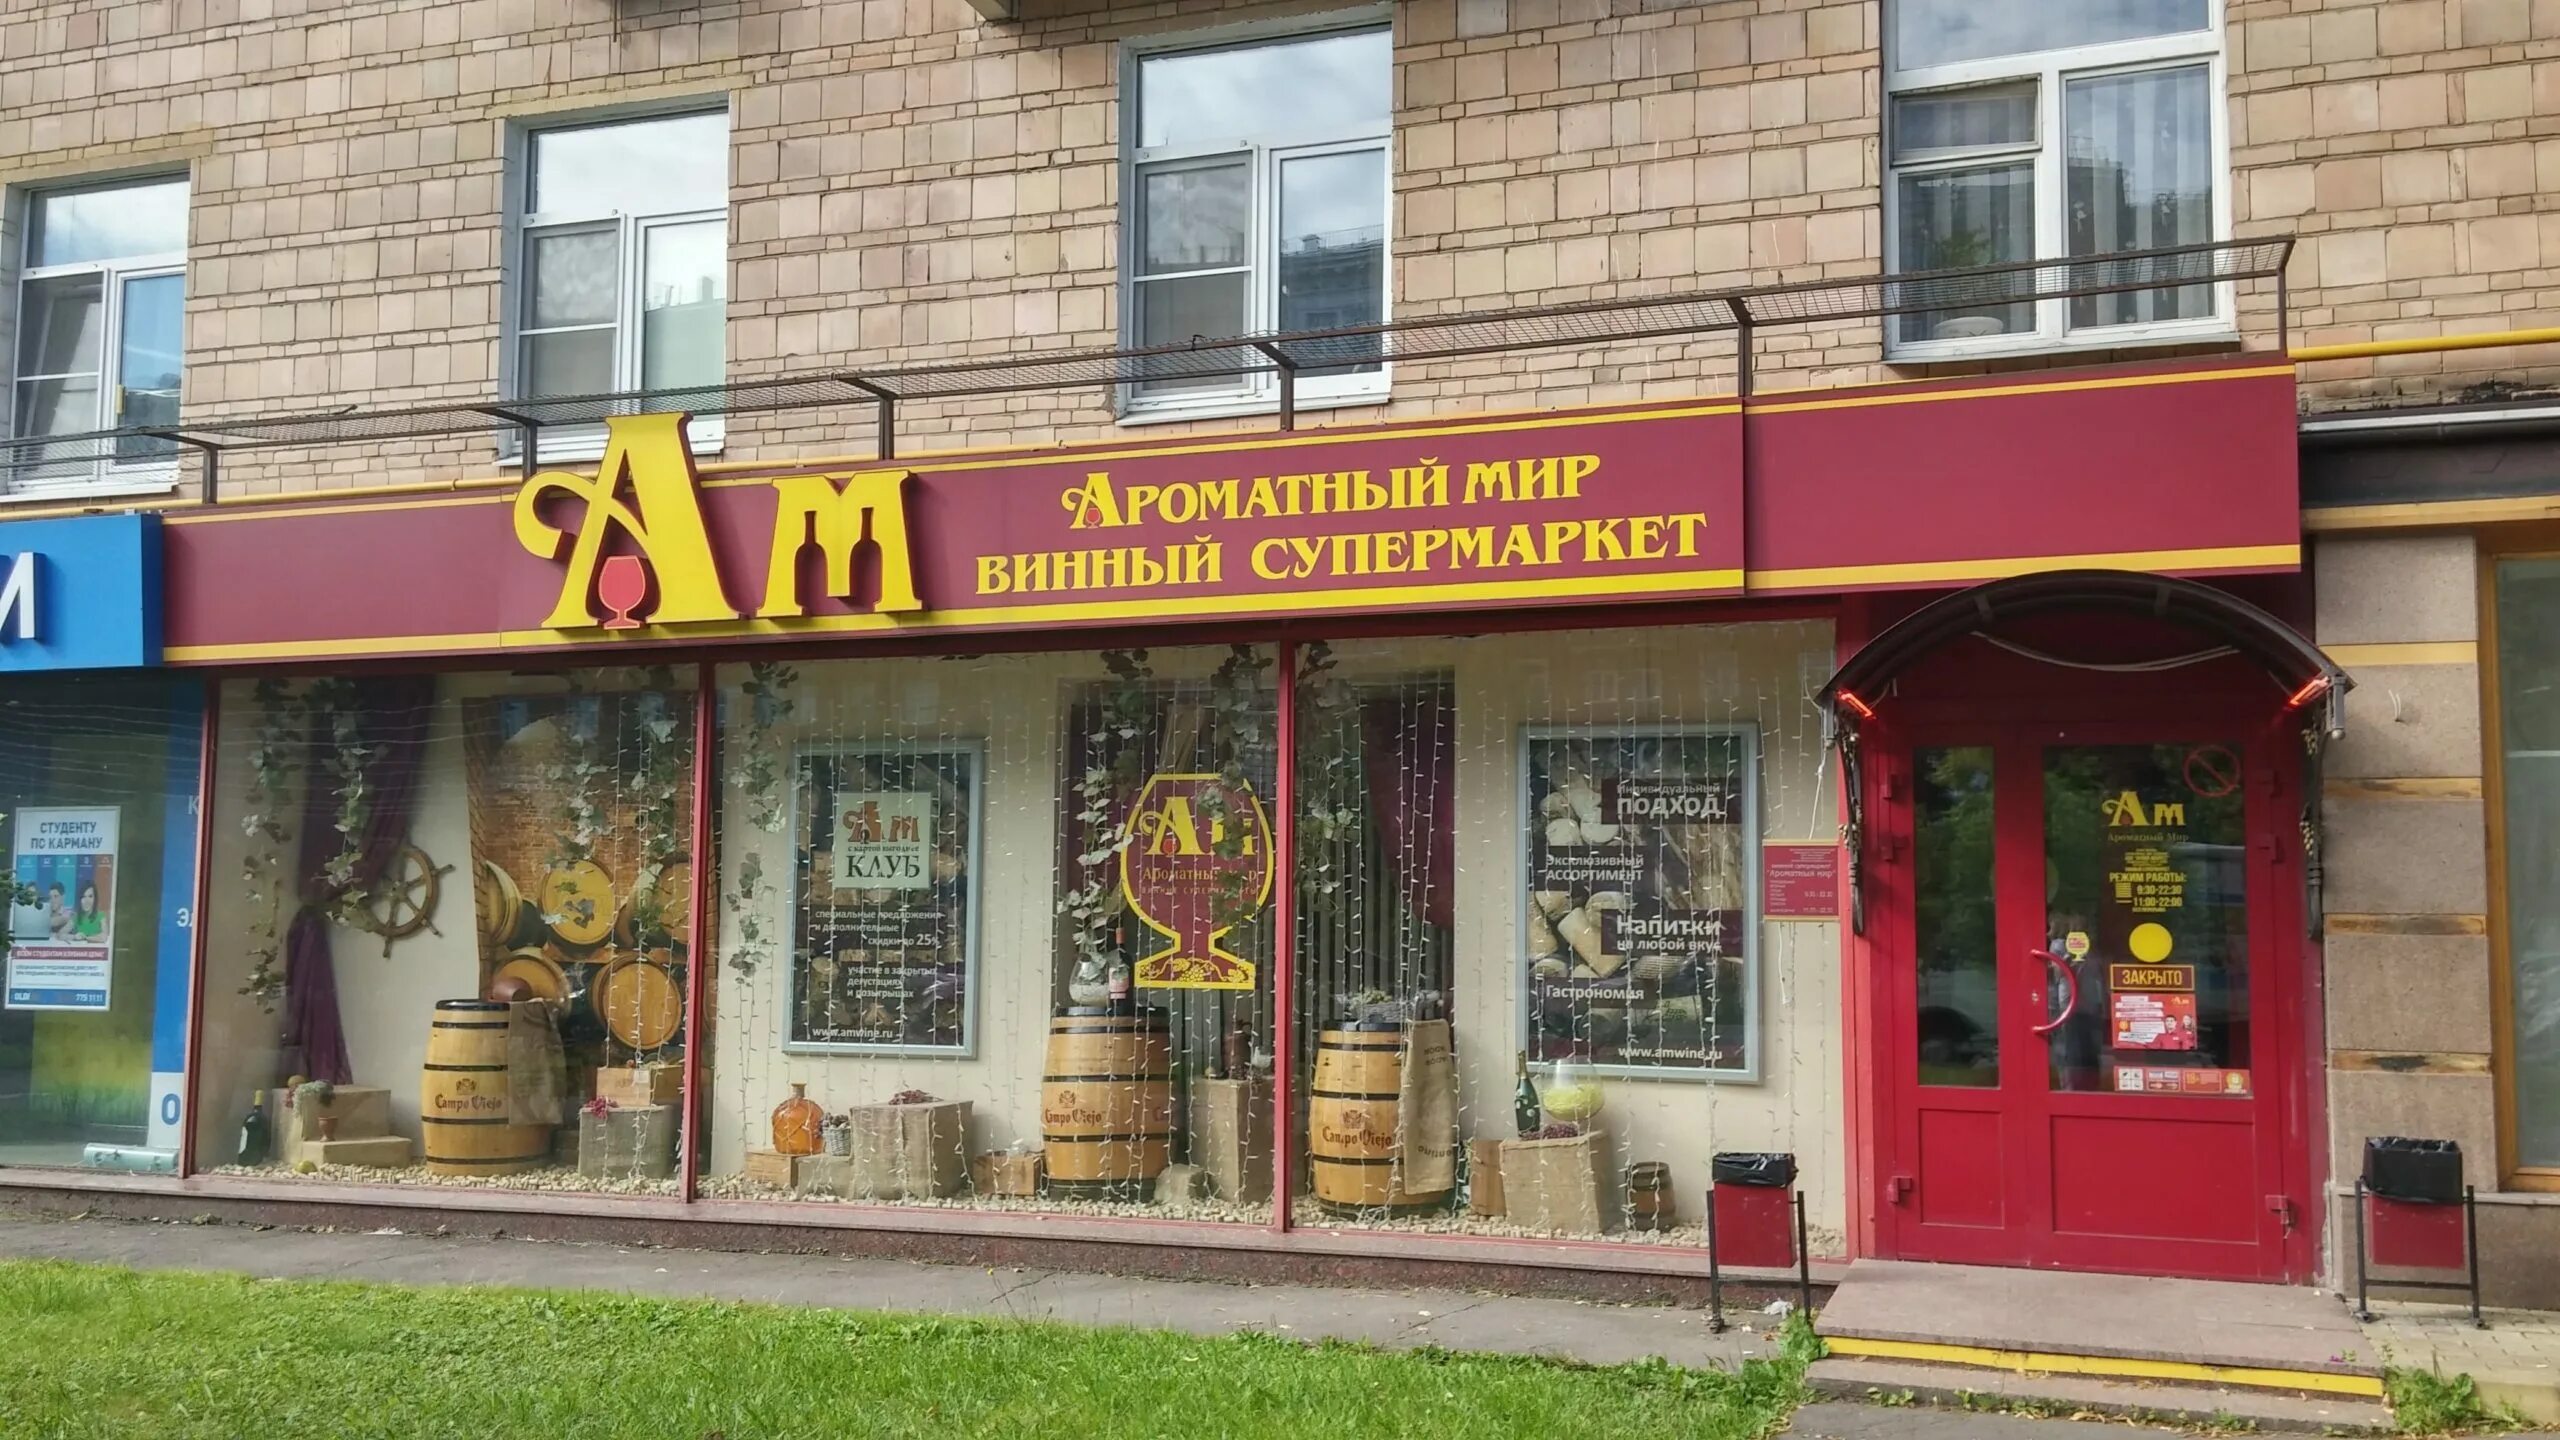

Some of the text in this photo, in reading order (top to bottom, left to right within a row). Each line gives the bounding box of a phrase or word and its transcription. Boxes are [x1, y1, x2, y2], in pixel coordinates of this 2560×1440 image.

[975, 512, 1707, 595] ВИННЫЙ СУПЕРМАРКЕТ
[1617, 782, 1720, 795] Индивидуальный
[40, 822, 97, 835] СТУДЕНТУ
[48, 836, 103, 849] КАРМАНУ
[1546, 854, 1644, 866] Эксклюзивный
[845, 855, 920, 879] КЛУБ
[1546, 869, 1644, 881] АССОРТИМЕНТ
[1616, 915, 1720, 936] Напитки
[1638, 938, 1685, 950] любой
[847, 966, 882, 975] участие
[2122, 969, 2182, 985] ЗАКРЫТО
[1546, 985, 1644, 1000] Гастрономия
[812, 1028, 893, 1038] www.amwine.ru
[1618, 1047, 1722, 1060] www.amwine.ru
